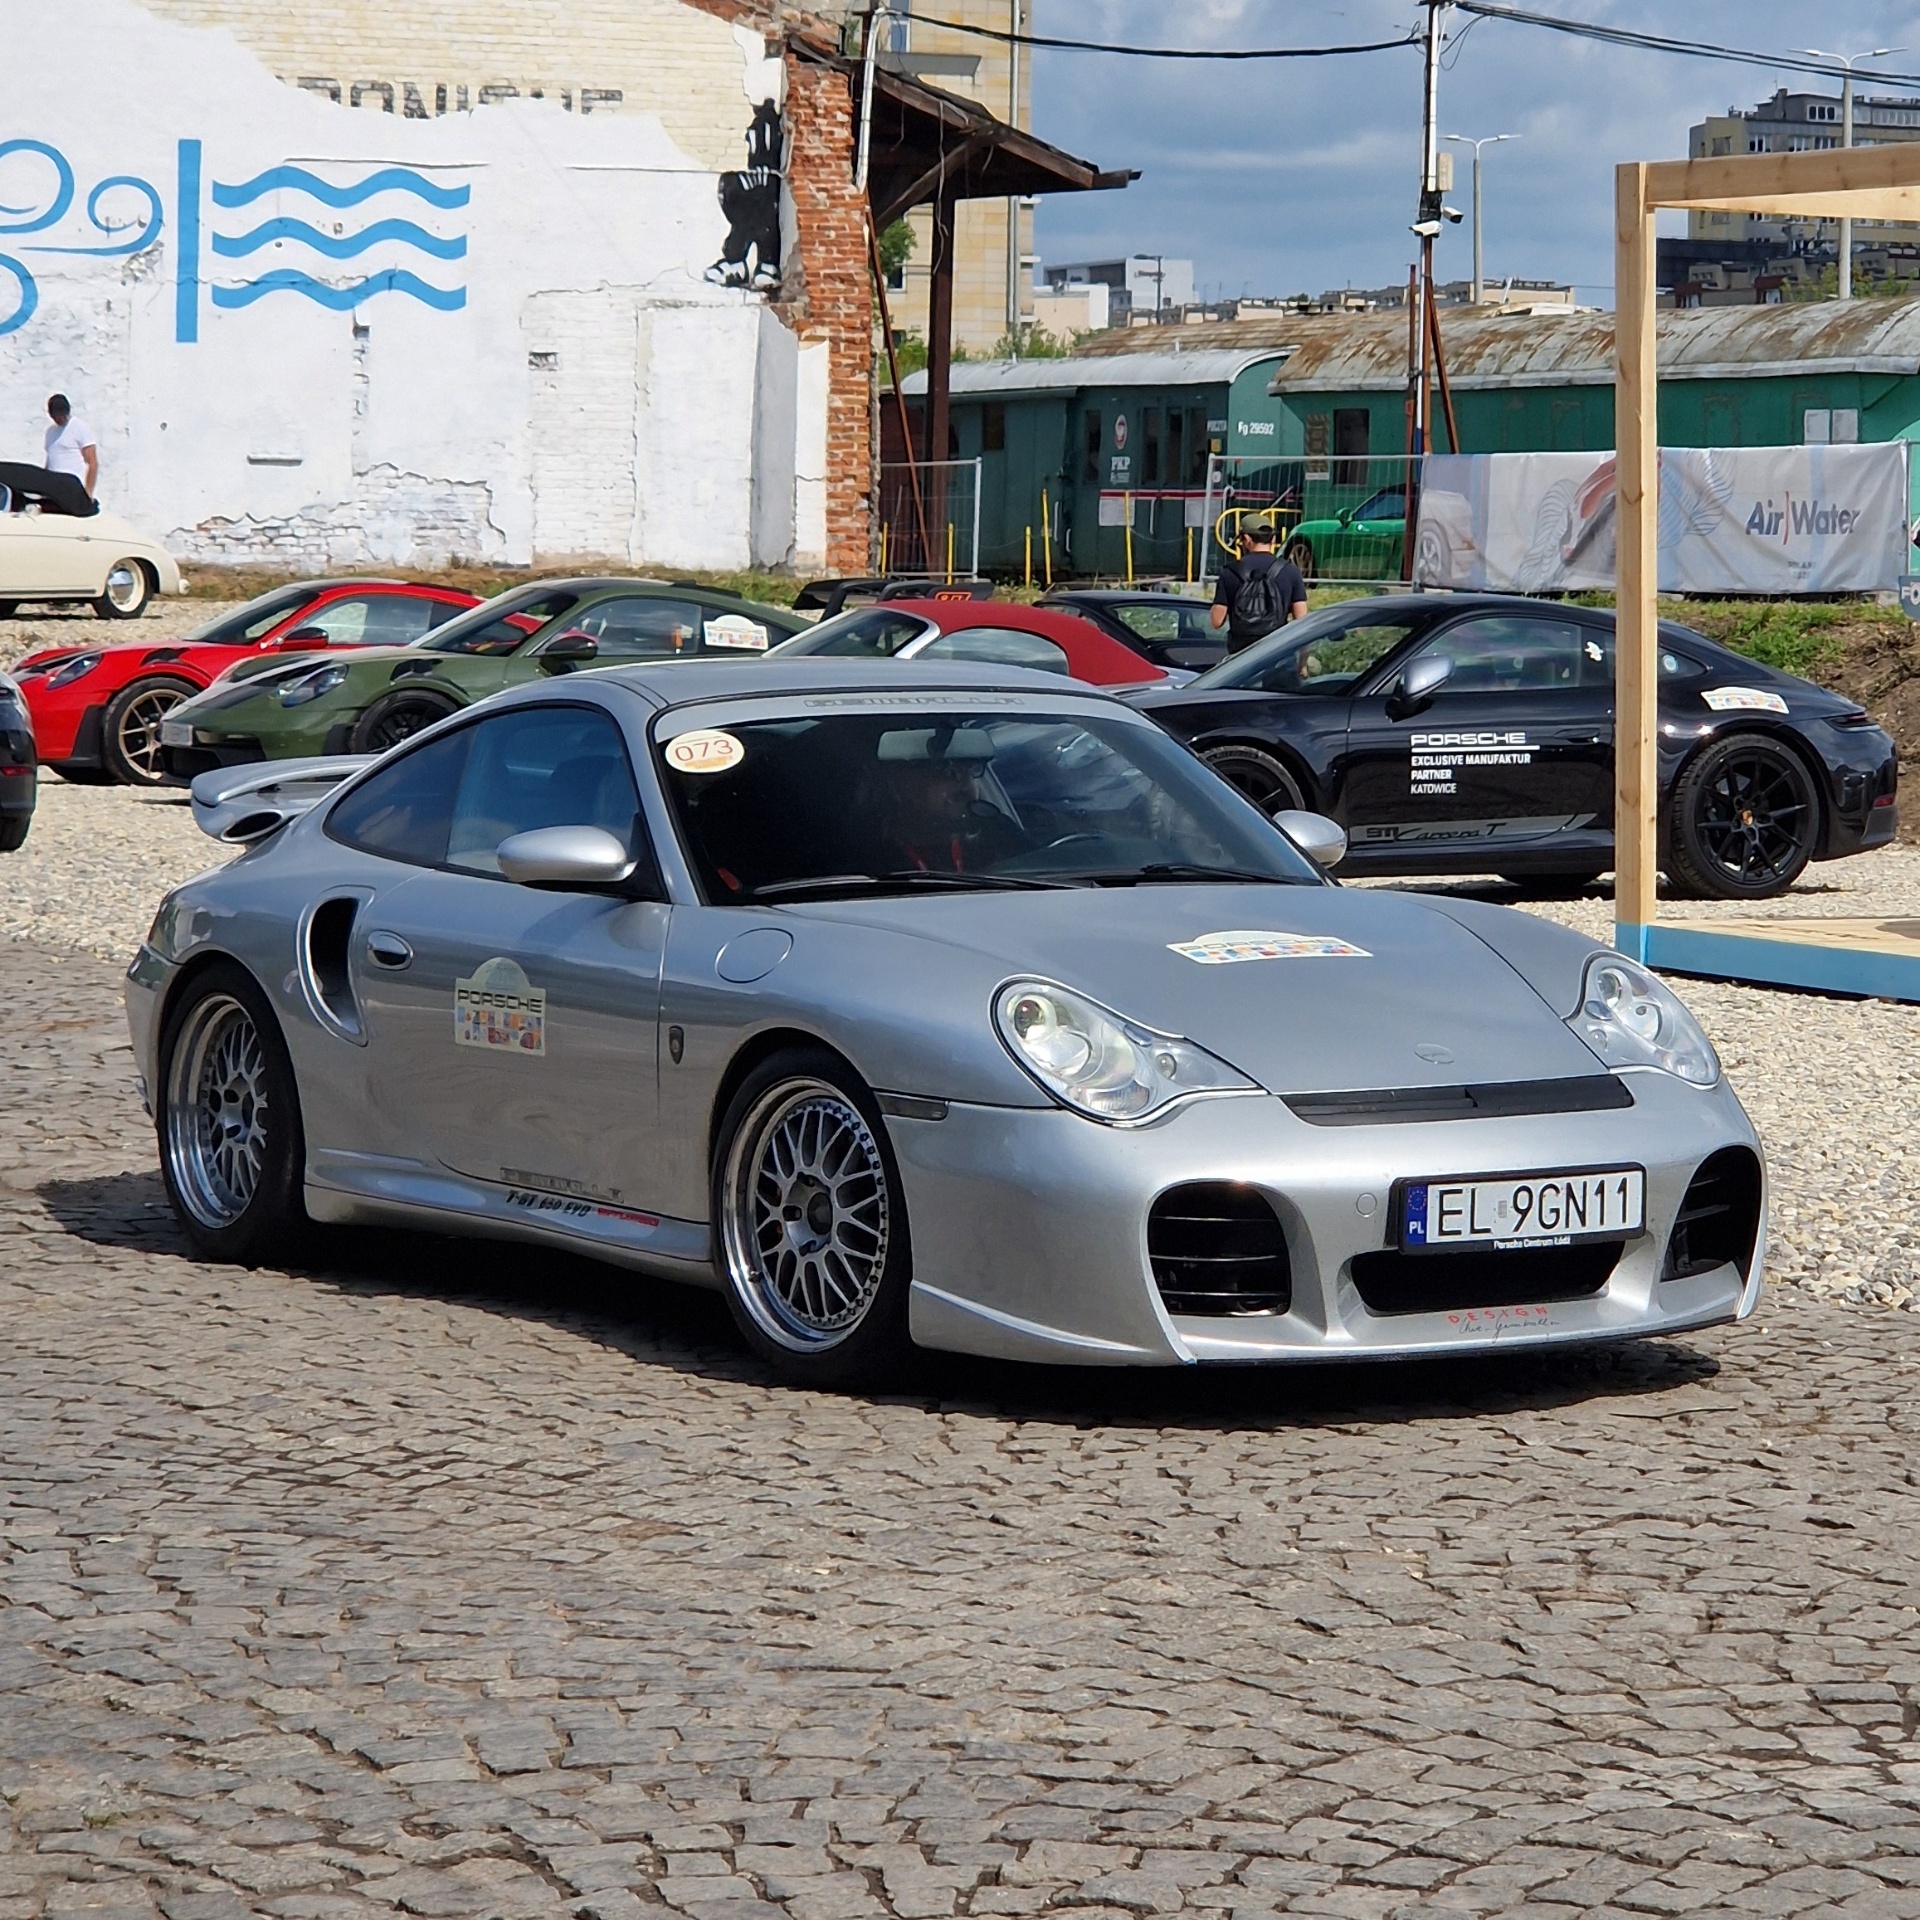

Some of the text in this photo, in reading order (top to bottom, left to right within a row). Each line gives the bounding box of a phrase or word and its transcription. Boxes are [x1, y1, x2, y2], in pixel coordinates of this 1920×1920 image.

[1111, 456, 1131, 471] PKP
[1745, 499, 1862, 536] Air Water
[1410, 731, 1527, 746] PORSCHE
[674, 739, 734, 762] 073
[1411, 752, 1532, 767] EXCLUSIVE MANUFAKTUR
[1411, 769, 1453, 781] PARTNER
[1410, 782, 1458, 795] KATOWICE
[1395, 827, 1480, 842] Carrera
[1486, 821, 1508, 836] T
[457, 989, 543, 1014] PORSCHE
[1437, 1176, 1629, 1237] EL 9GN11
[1408, 1220, 1425, 1235] PL
[1447, 1306, 1548, 1324] DESIGN
